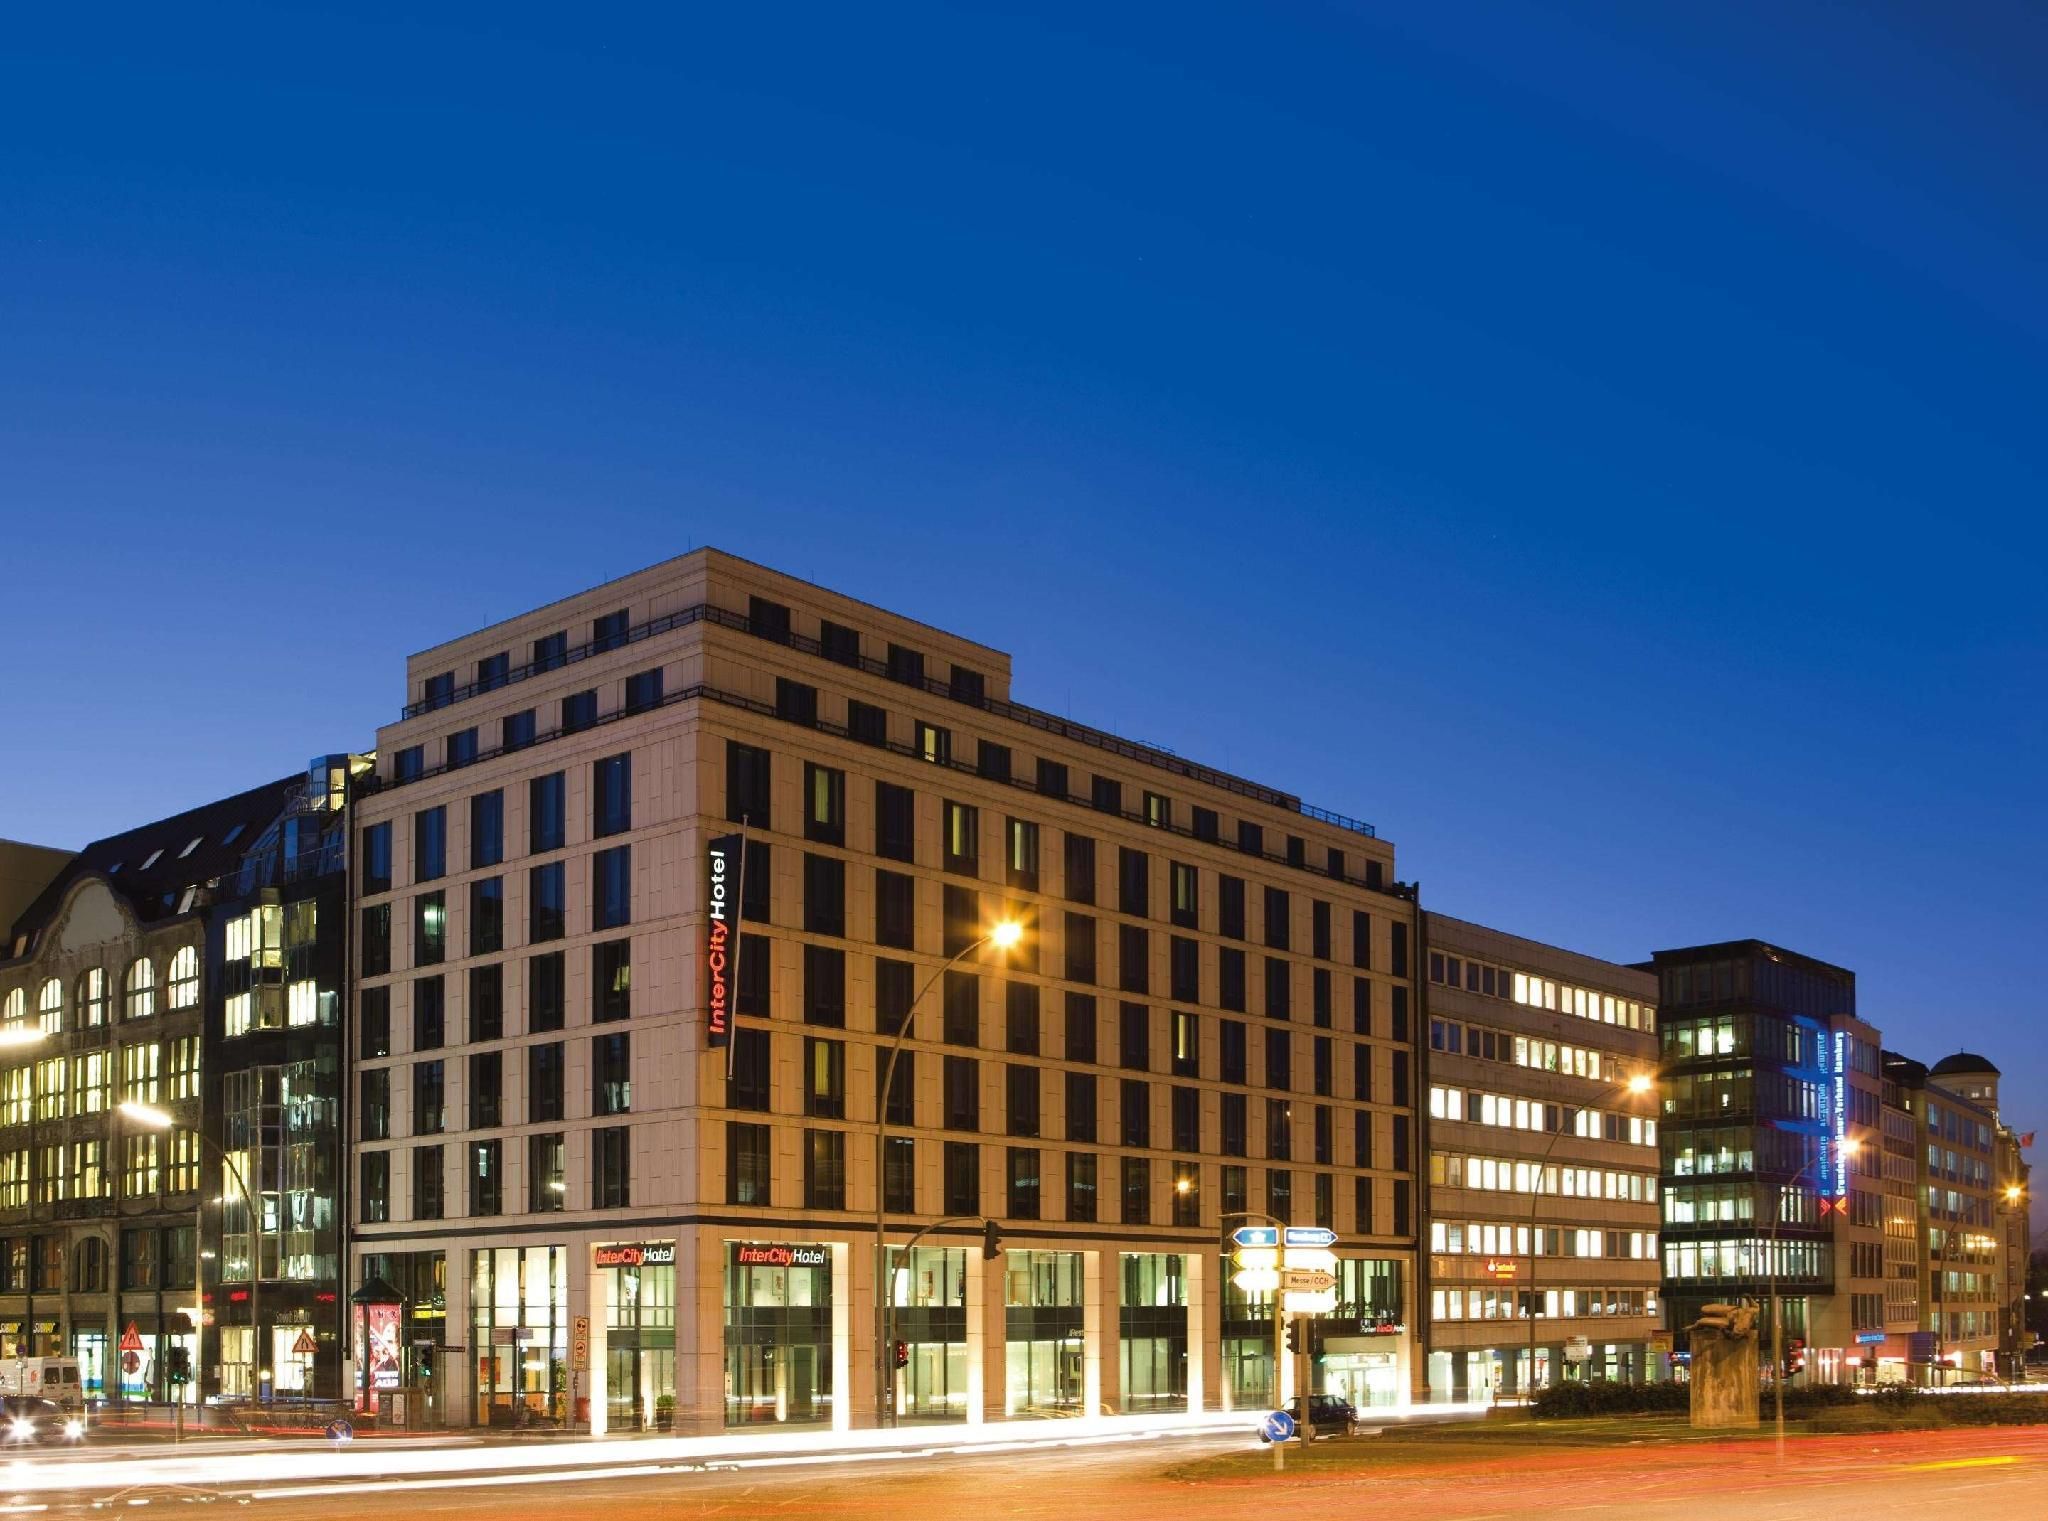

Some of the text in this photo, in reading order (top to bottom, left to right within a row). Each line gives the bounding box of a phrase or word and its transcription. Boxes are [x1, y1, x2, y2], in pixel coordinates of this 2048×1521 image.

[709, 850, 728, 1034] InterCityHotel
[1834, 1032, 1844, 1073] Hamburg
[597, 1247, 675, 1266] InterCityHotel
[739, 1247, 825, 1267] InterCityHotel
